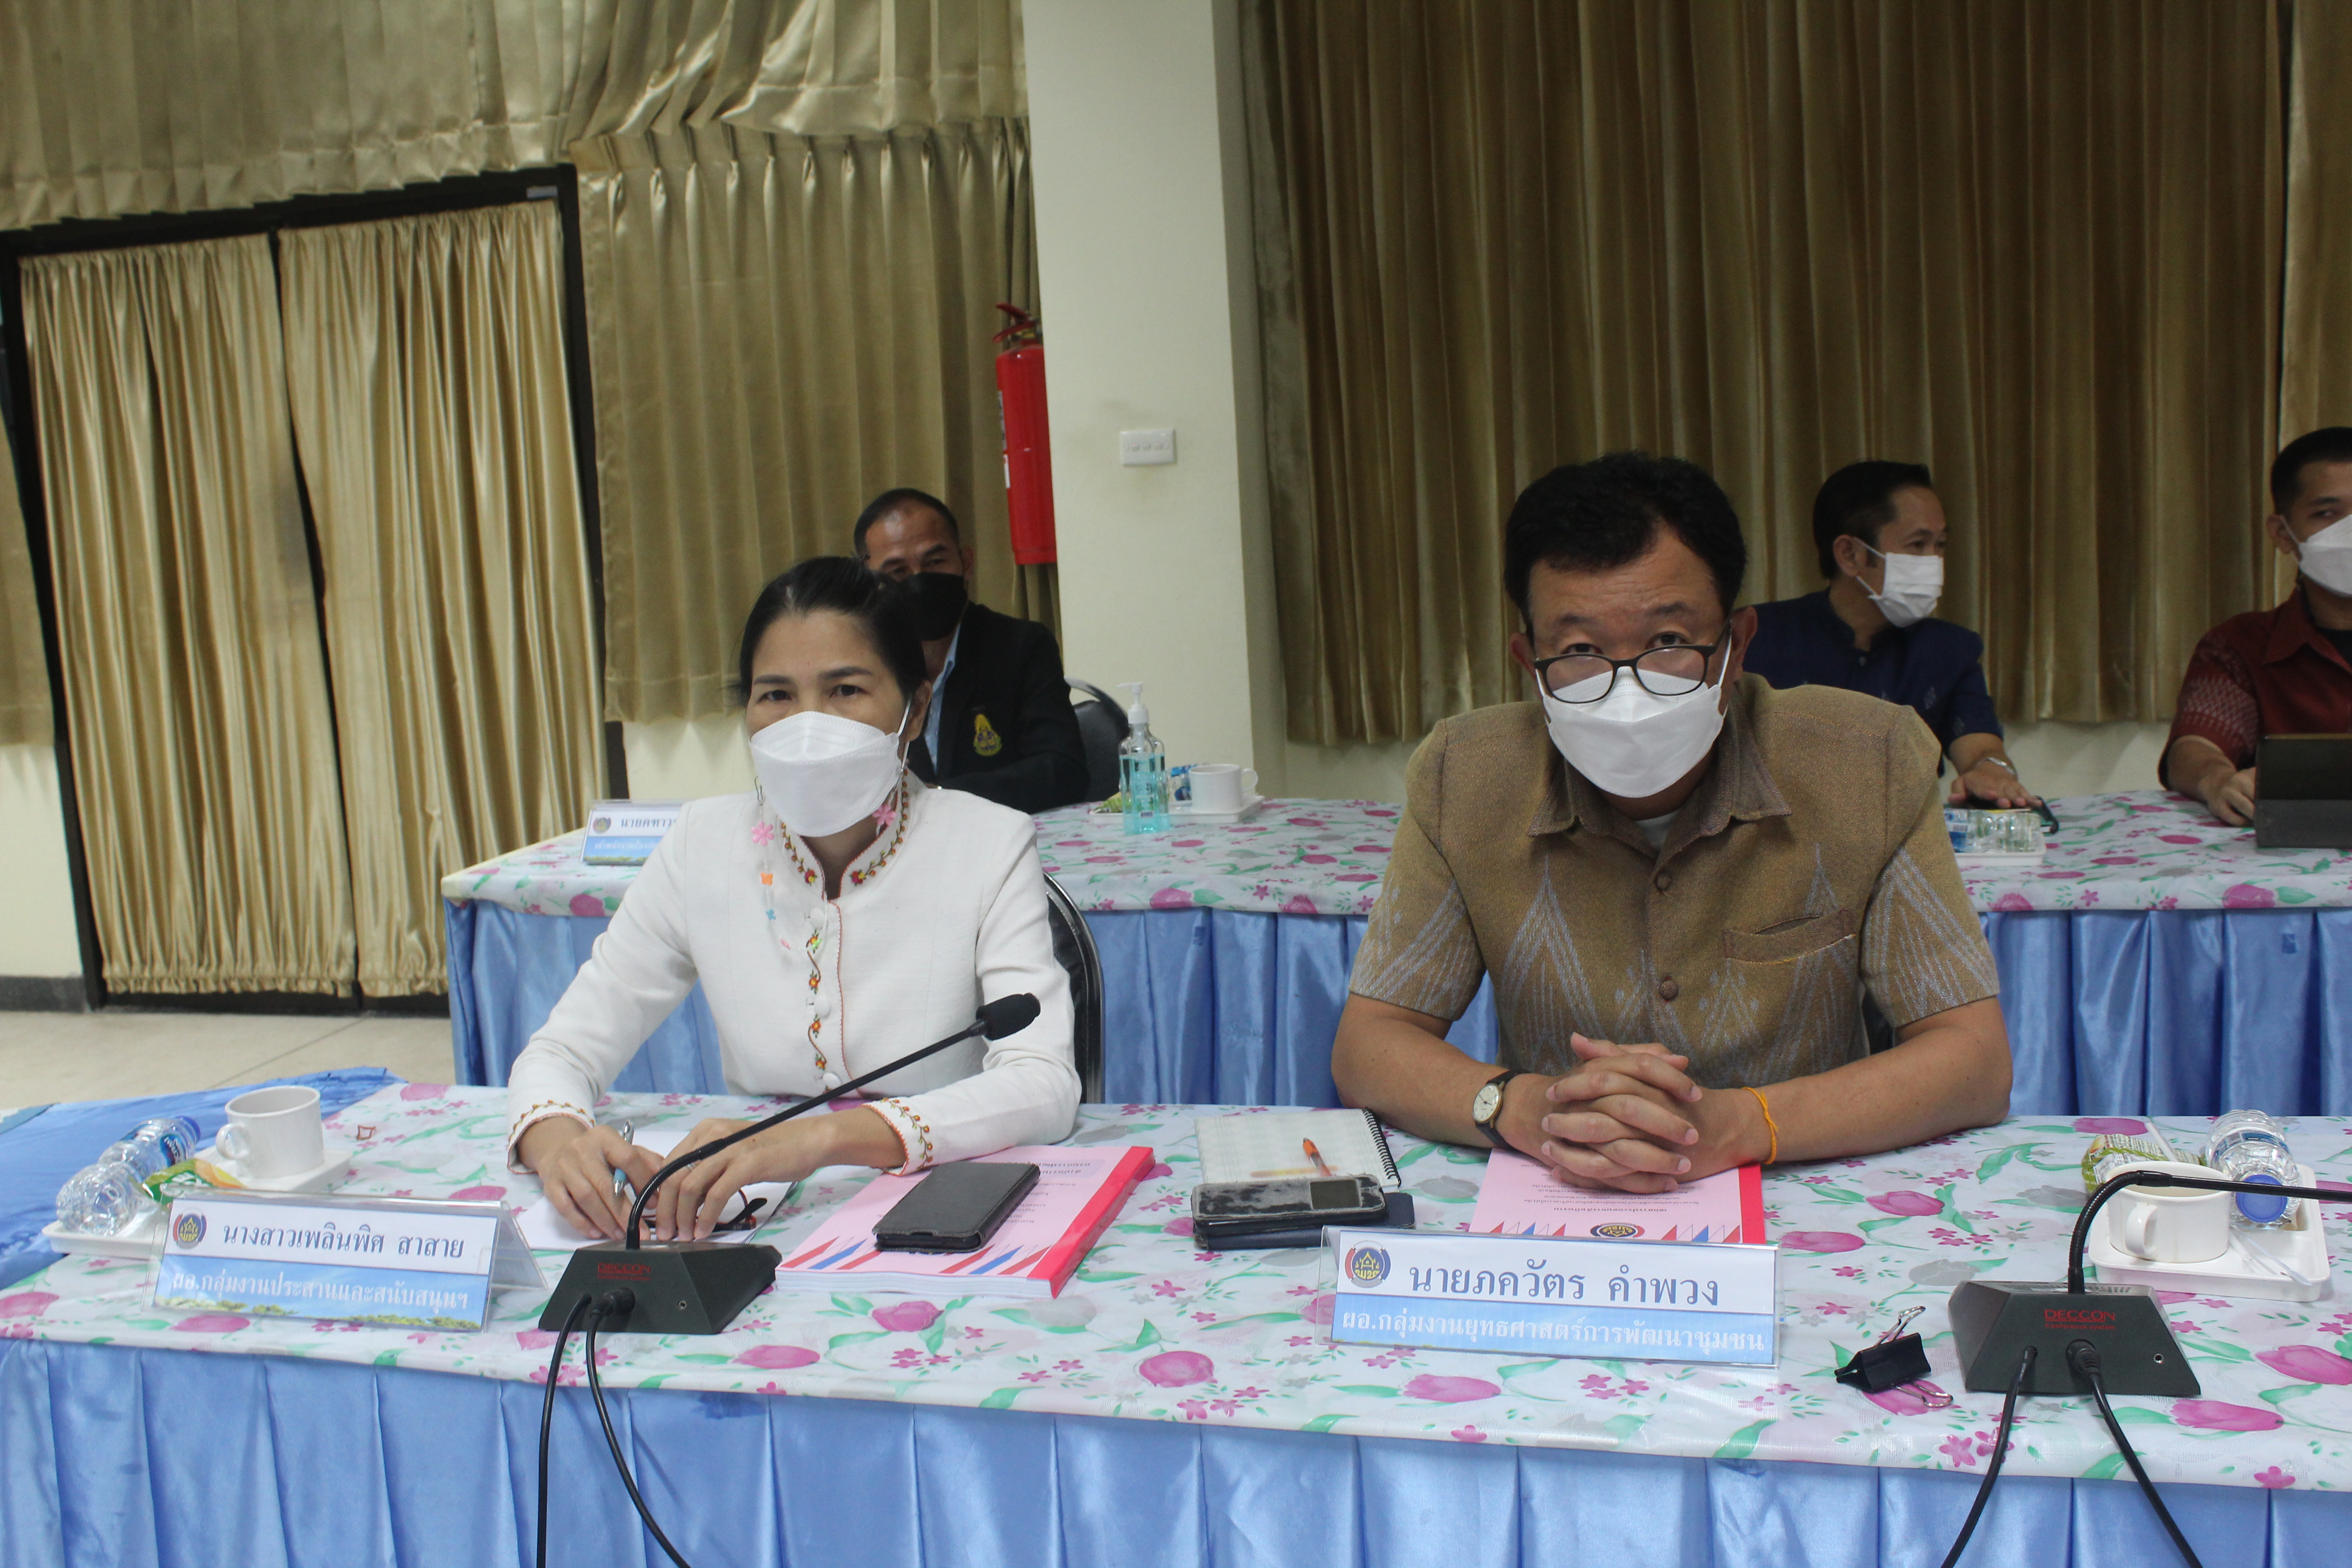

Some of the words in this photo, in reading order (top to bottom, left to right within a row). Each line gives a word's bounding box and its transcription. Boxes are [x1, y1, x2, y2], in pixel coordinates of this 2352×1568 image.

[223, 1222, 384, 1254] นางสาวเพลินพิศ
[397, 1235, 465, 1258] สาสาย
[598, 1262, 651, 1273] DECCON
[1409, 1259, 1585, 1299] นายภควัตร
[1609, 1265, 1719, 1307] คำพวง
[2044, 1309, 2116, 1322] DECCON
